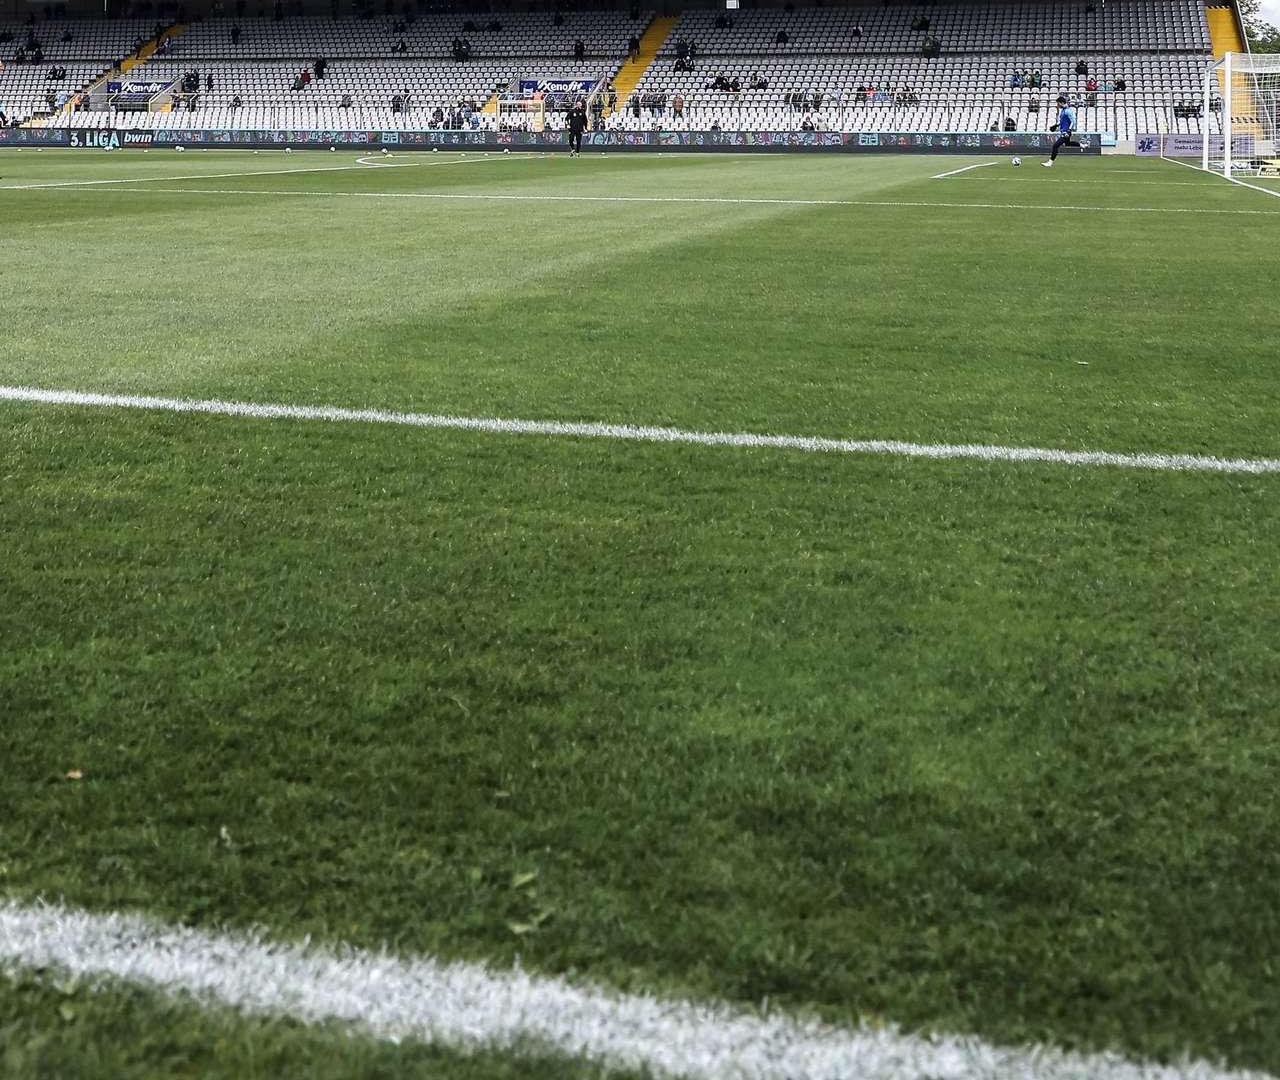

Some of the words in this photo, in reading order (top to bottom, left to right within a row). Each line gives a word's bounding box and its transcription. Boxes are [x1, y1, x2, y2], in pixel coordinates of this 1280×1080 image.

[70, 130, 83, 147] 3.
[85, 130, 120, 147] LIGA
[124, 131, 153, 143] bwin
